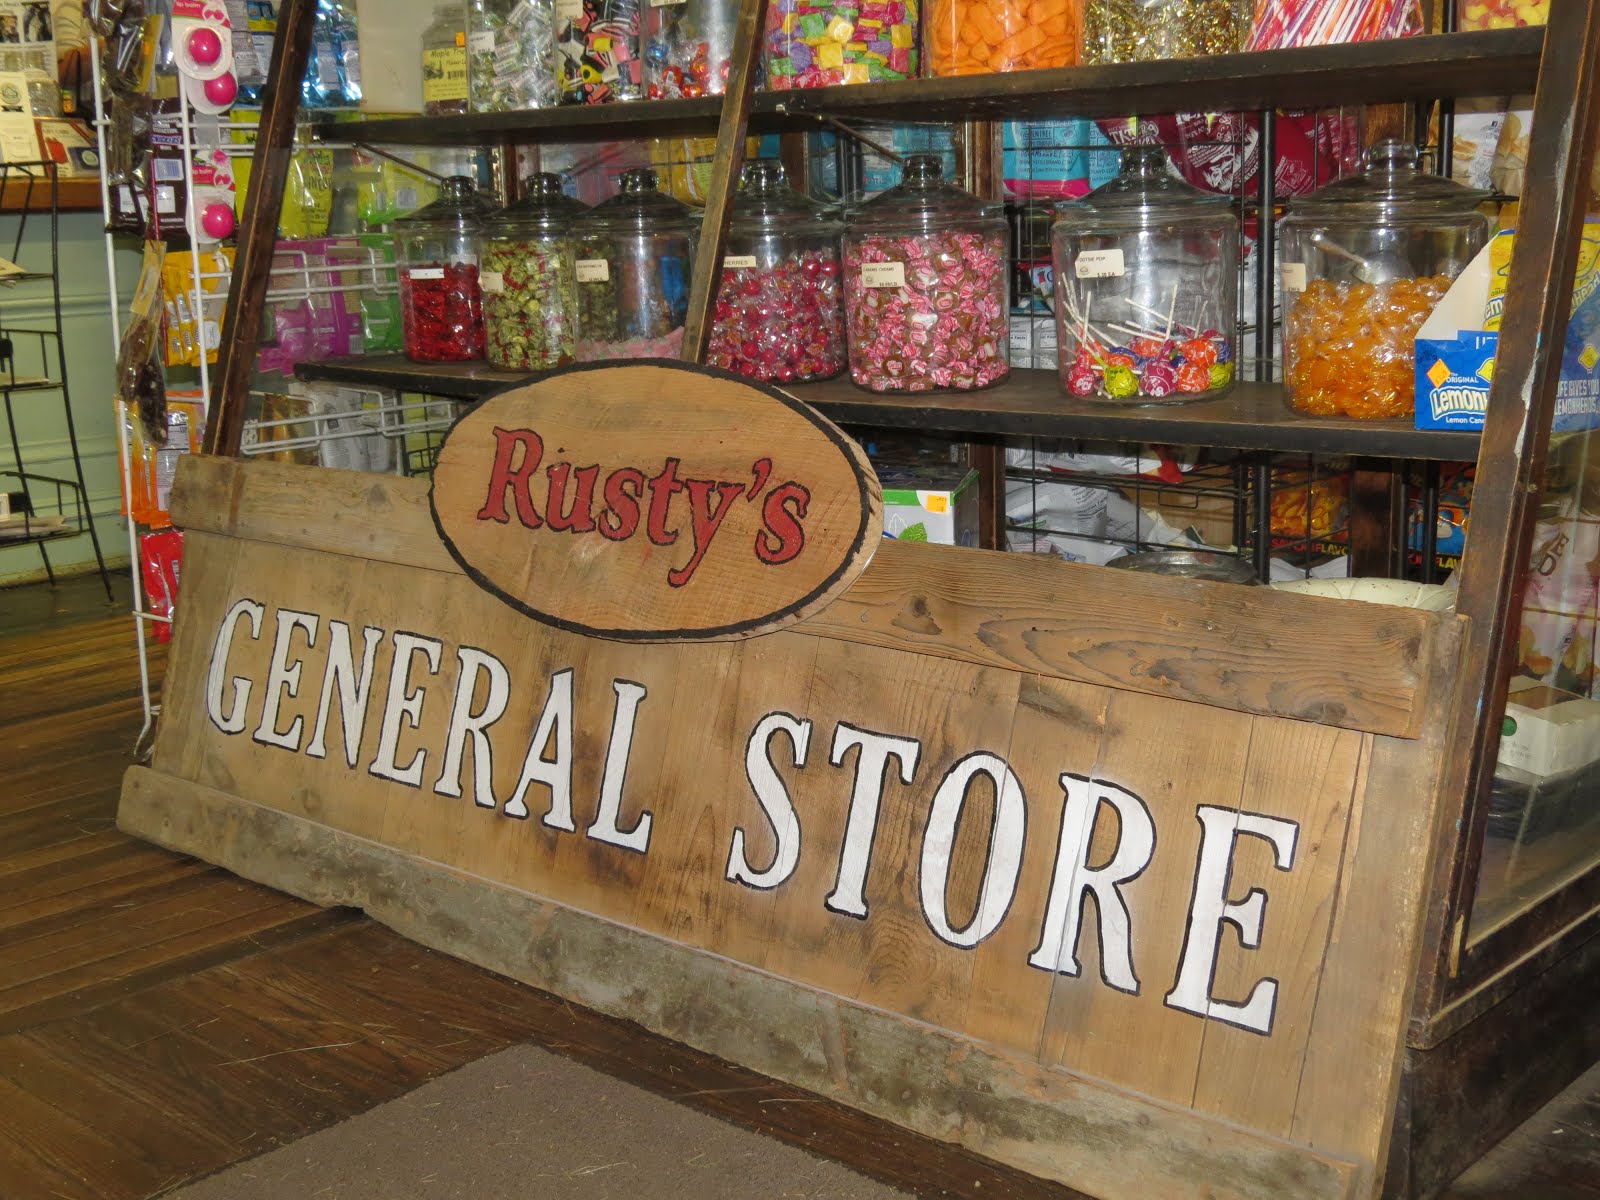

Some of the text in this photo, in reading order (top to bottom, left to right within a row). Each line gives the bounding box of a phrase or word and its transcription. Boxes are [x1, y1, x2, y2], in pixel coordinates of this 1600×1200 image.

[1445, 376, 1479, 384] ORIGINAL
[1445, 416, 1469, 424] Lemon
[477, 425, 811, 588] Rusty's
[206, 598, 1301, 1037] GENERAL STORE
